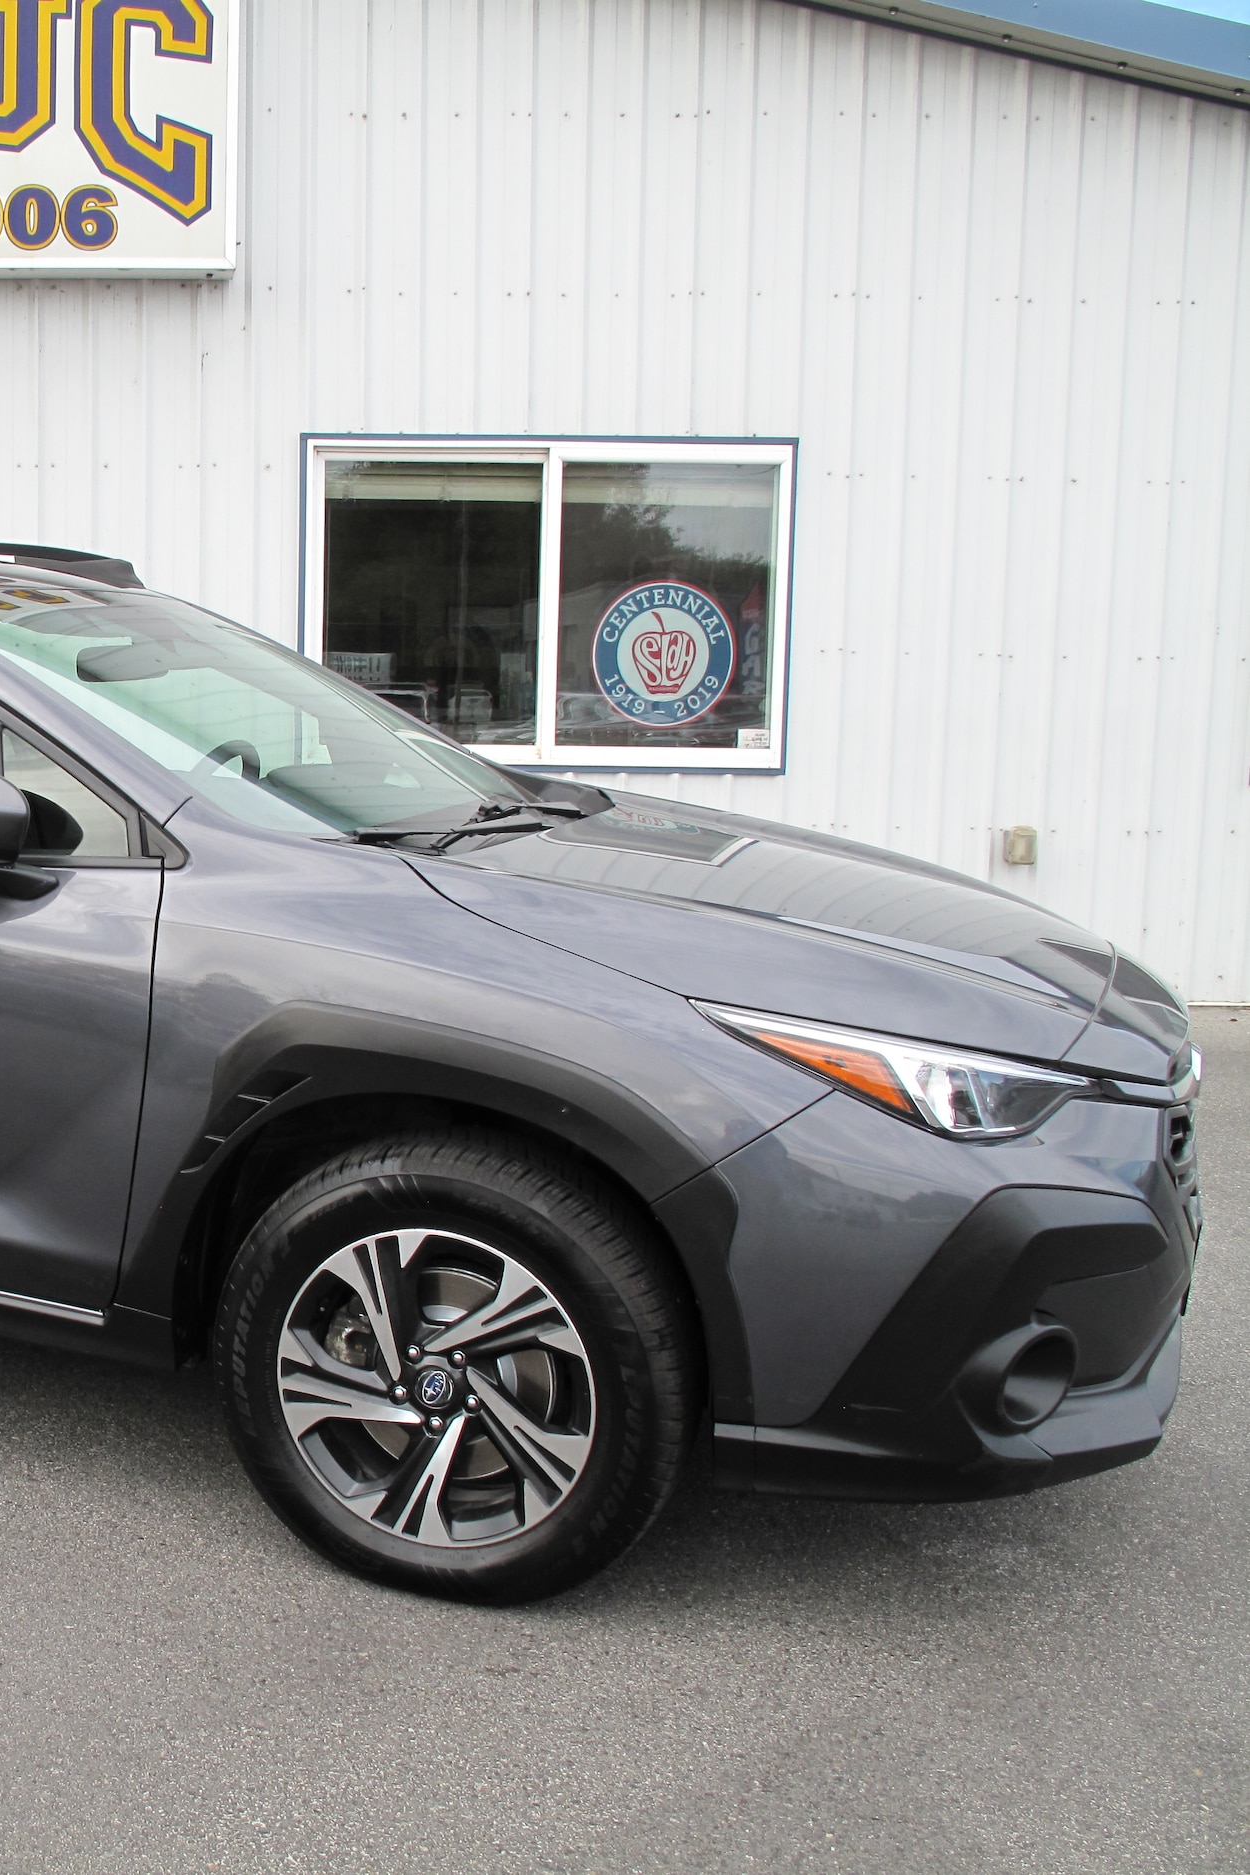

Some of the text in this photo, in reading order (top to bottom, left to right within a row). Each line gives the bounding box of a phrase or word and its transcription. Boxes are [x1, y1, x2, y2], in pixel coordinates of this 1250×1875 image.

[602, 588, 725, 645] CENTENNIAL
[605, 674, 645, 714] 1919
[674, 675, 719, 717] 2019
